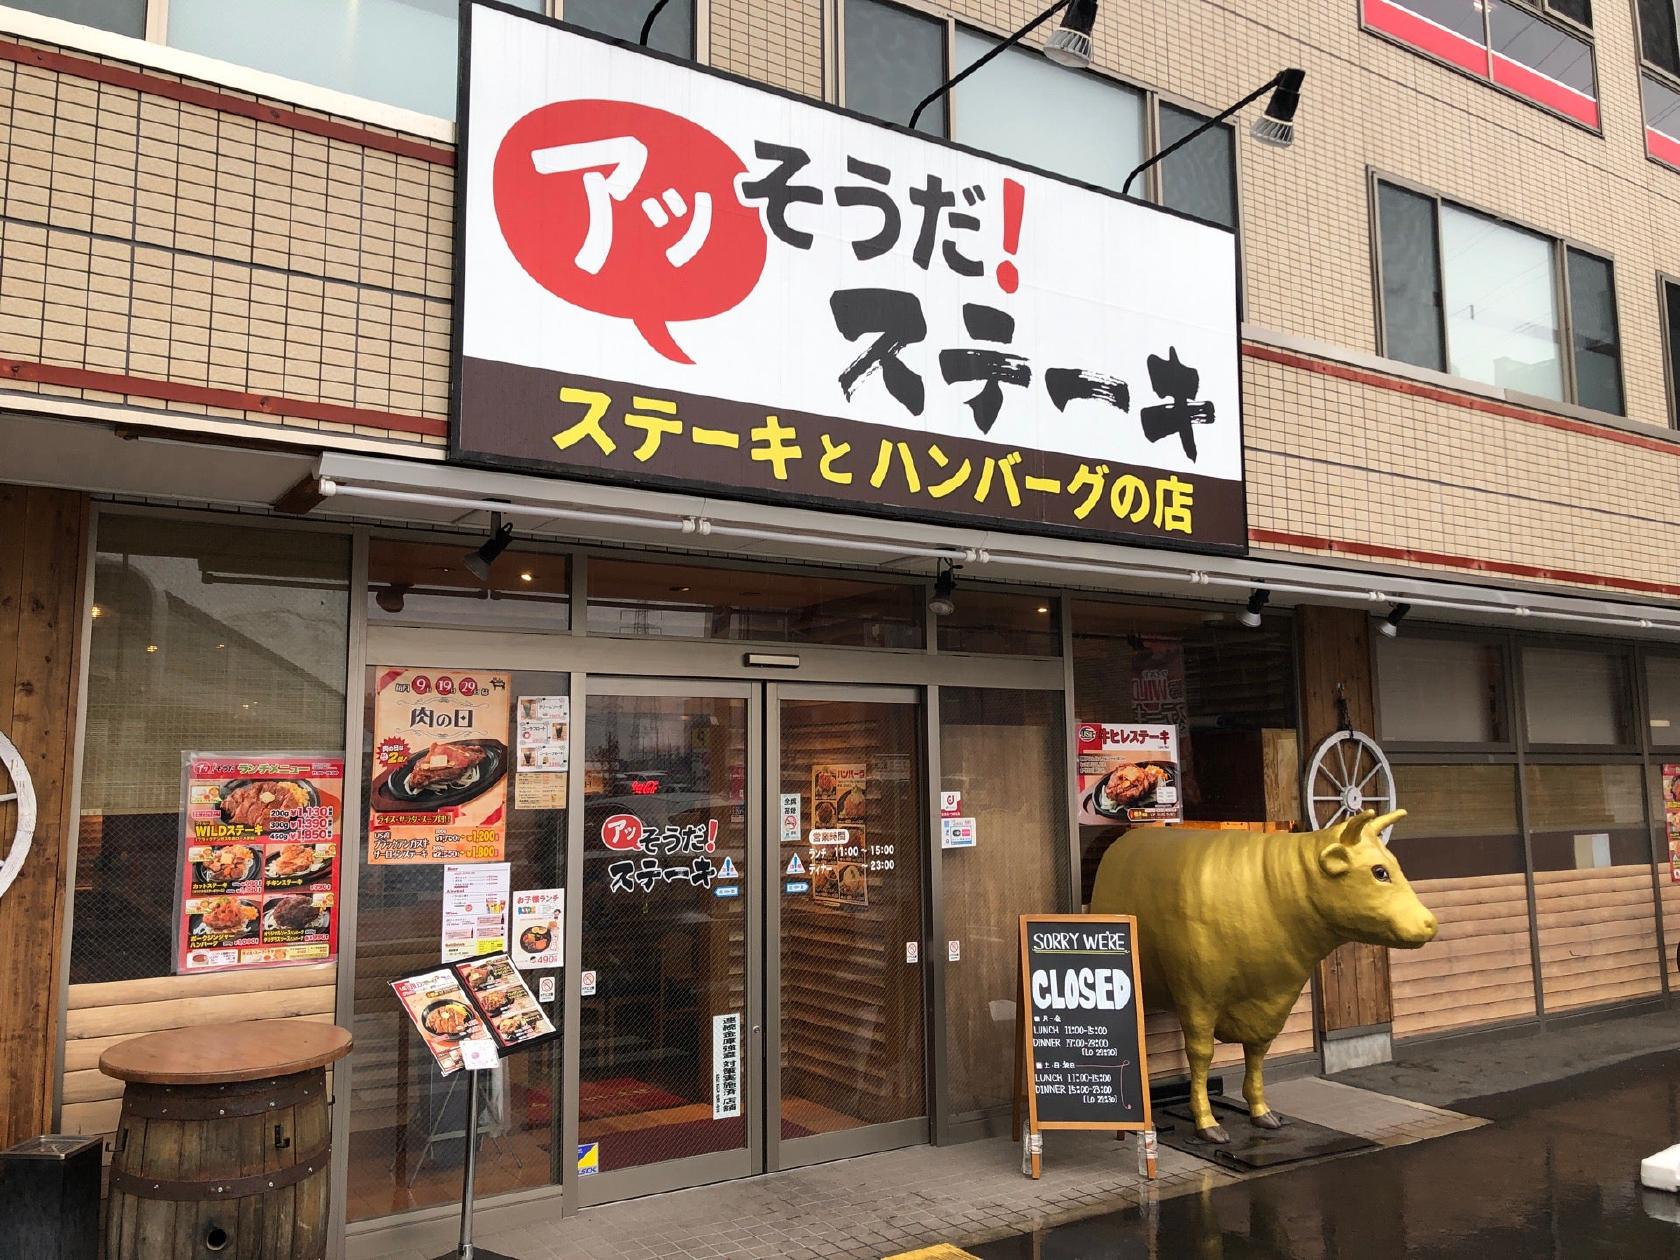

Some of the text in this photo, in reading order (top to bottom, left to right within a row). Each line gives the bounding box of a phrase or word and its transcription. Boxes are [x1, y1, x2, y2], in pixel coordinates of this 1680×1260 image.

[829, 287, 1216, 463] ステーキ
[410, 707, 473, 728] 肉の日
[608, 856, 717, 892] ステーキ
[1032, 932, 1080, 951] SORRY
[1032, 967, 1131, 1011] CLOSED
[1033, 1025, 1060, 1035] LUNCH
[1032, 1038, 1061, 1047] DINNER
[1034, 1073, 1063, 1082] LUNCH
[1034, 1085, 1067, 1094] DINNER
